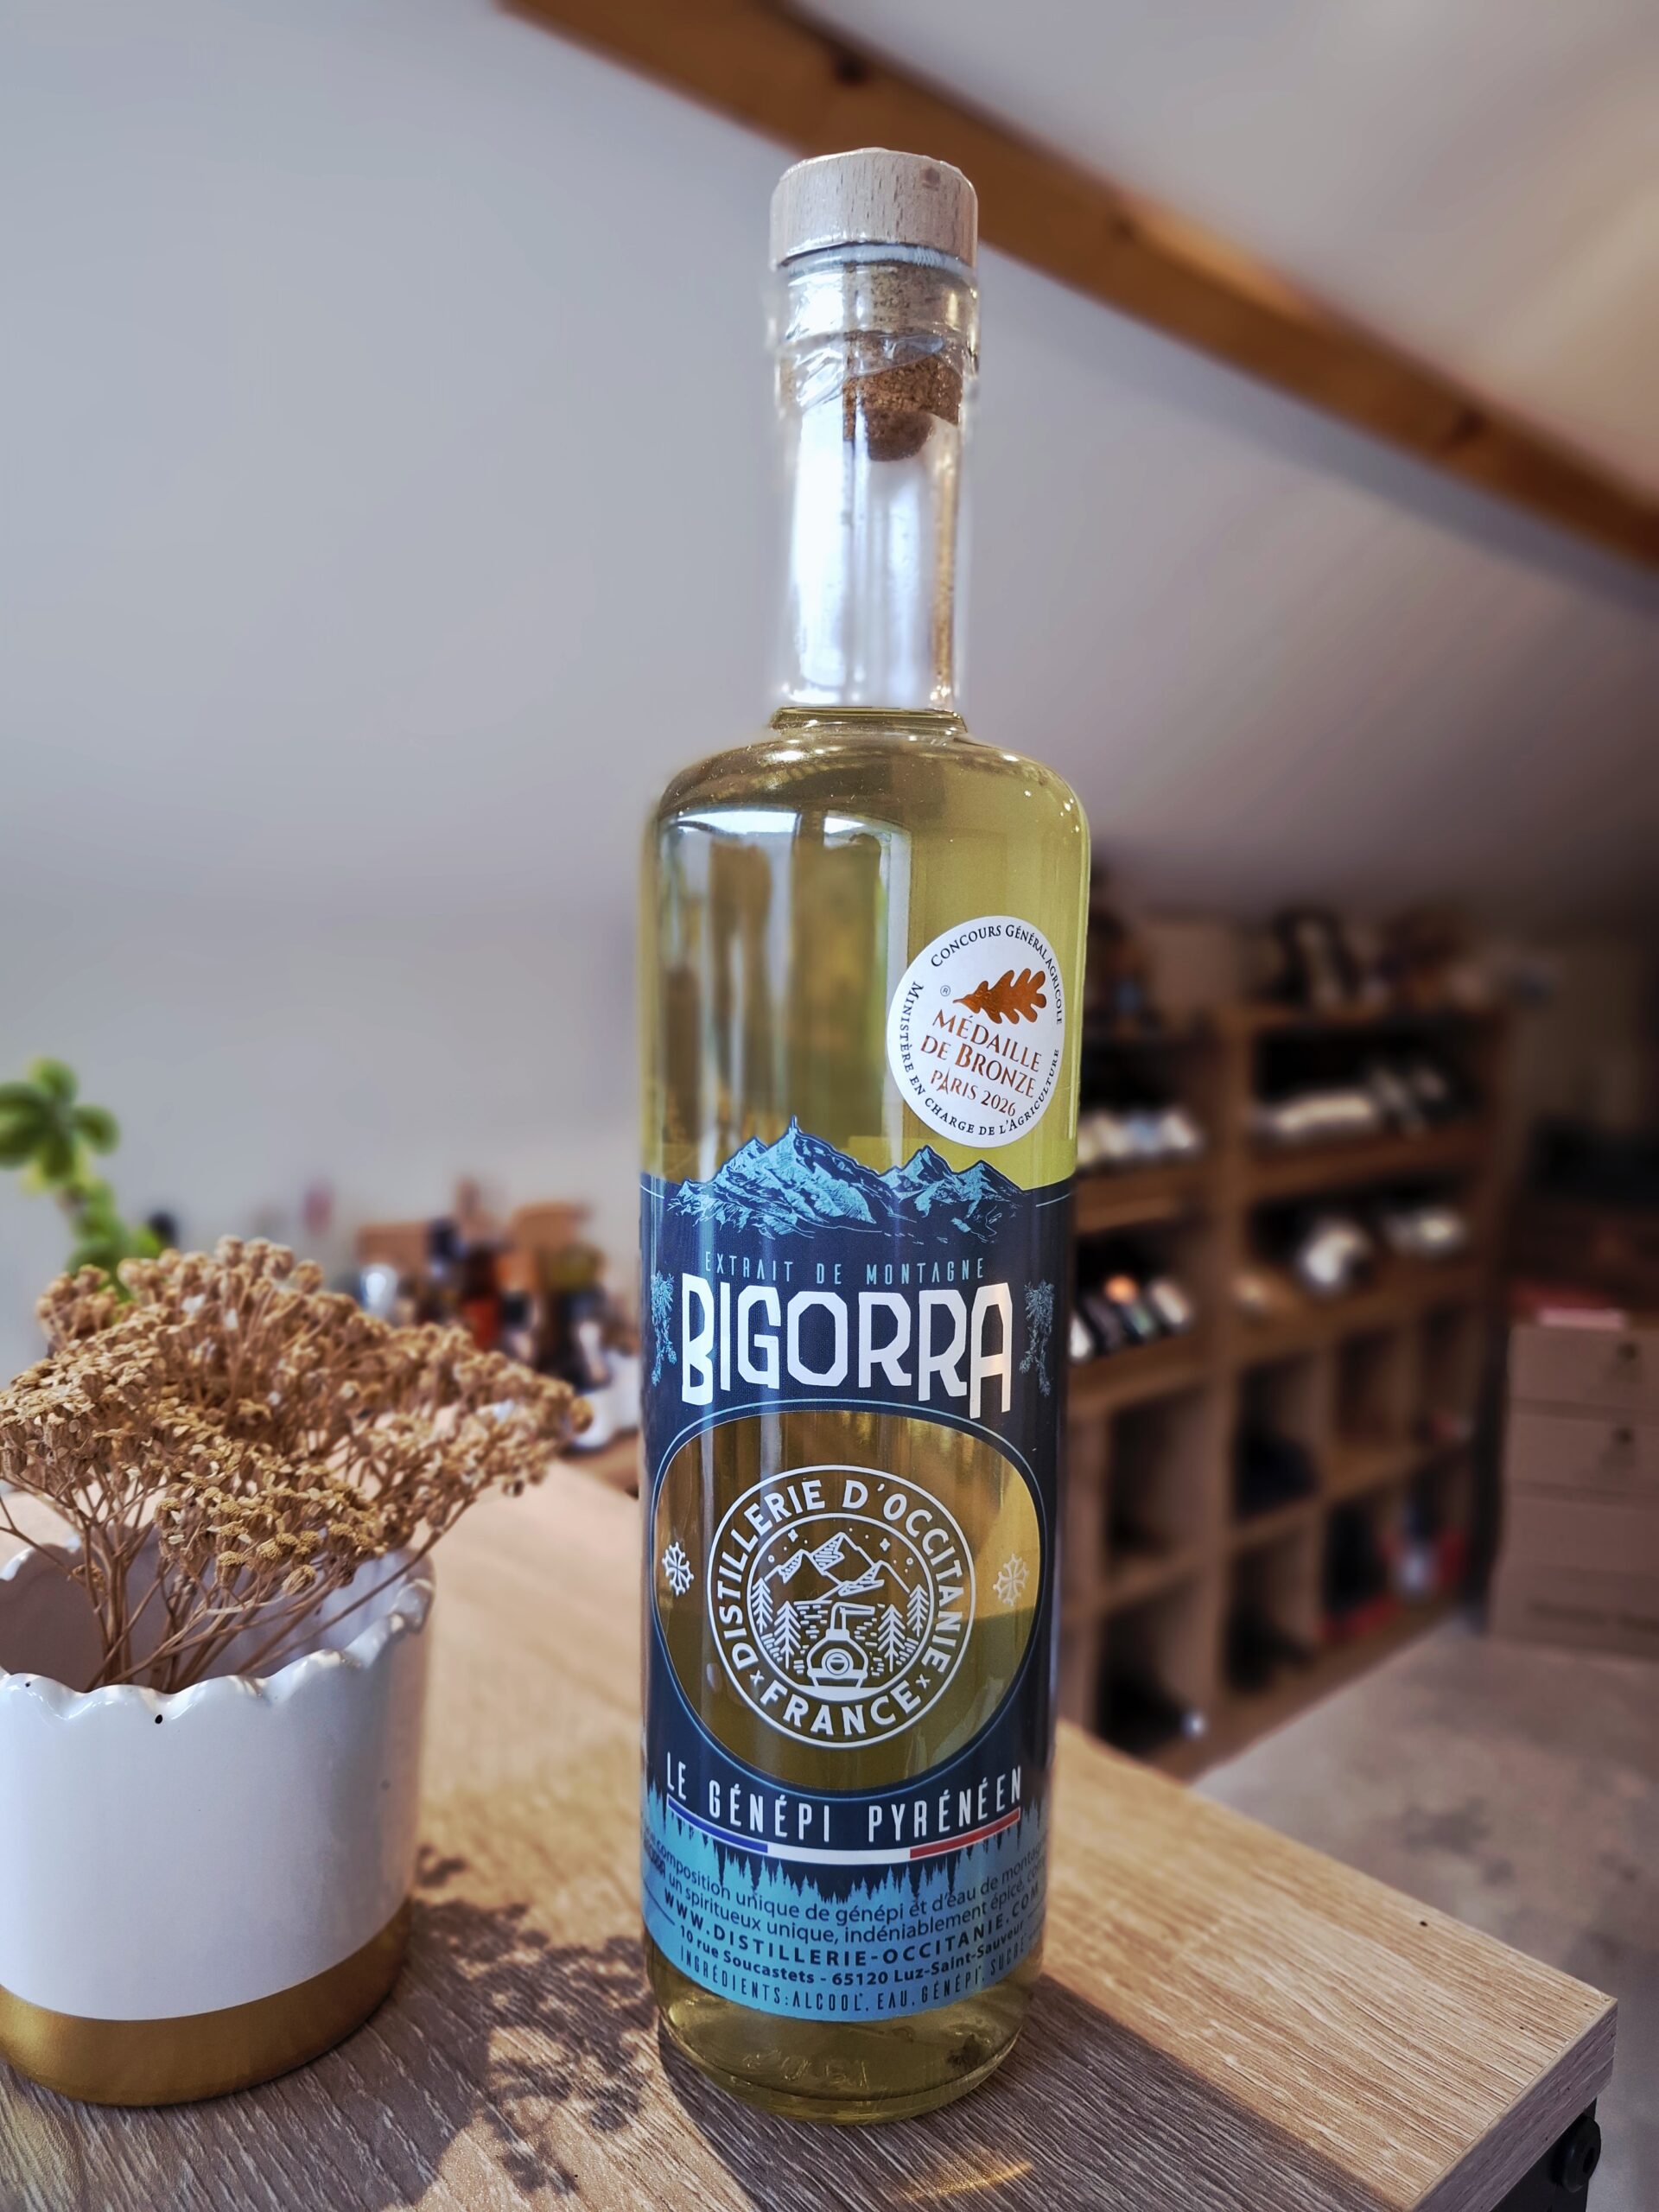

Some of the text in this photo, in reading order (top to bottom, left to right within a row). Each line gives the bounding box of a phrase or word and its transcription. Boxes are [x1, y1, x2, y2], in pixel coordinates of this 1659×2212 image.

[931, 924, 1062, 1025] CONCOURS GÉNÉRAL AGRICOLE
[899, 981, 1060, 1135] MINISTÈRE EN CHARGE DE L'AGRICULTURE
[921, 1035, 1037, 1098] DE BRONZE
[932, 1008, 1042, 1072] MÉDAILLE
[931, 1068, 1016, 1116] PARIS 2026
[705, 1251, 985, 1285] EXTRAIT DE MONTAGNE
[682, 1272, 1013, 1419] BIGORRA
[716, 1478, 965, 1673] DISTILLERIE D'OCCITANIE
[760, 1679, 921, 1737] FRANCE
[667, 1751, 1021, 1843] LE GÉNÉPI PYRÉNÉEN
[657, 1839, 731, 1901] composition
[736, 1893, 800, 1919] unique
[804, 1904, 830, 1922] de
[836, 1903, 904, 1927] génépi
[909, 1901, 928, 1917] et
[931, 1886, 976, 1912] d'eau
[980, 1875, 998, 1895] de
[669, 1872, 683, 1894] un
[685, 1887, 761, 1931] spiritueux
[766, 1922, 840, 1944] unique,
[843, 1903, 987, 1943] indéniablement
[664, 1881, 1039, 1967] WWW.DISTILLERIE-OCCITANIE.COM
[680, 1924, 694, 1943] 10
[696, 1938, 719, 1959] rue
[723, 1949, 815, 1984] Soucastets
[831, 1972, 889, 1986] 65120
[893, 1920, 1025, 1984] Luz-Saint-Sauveur
